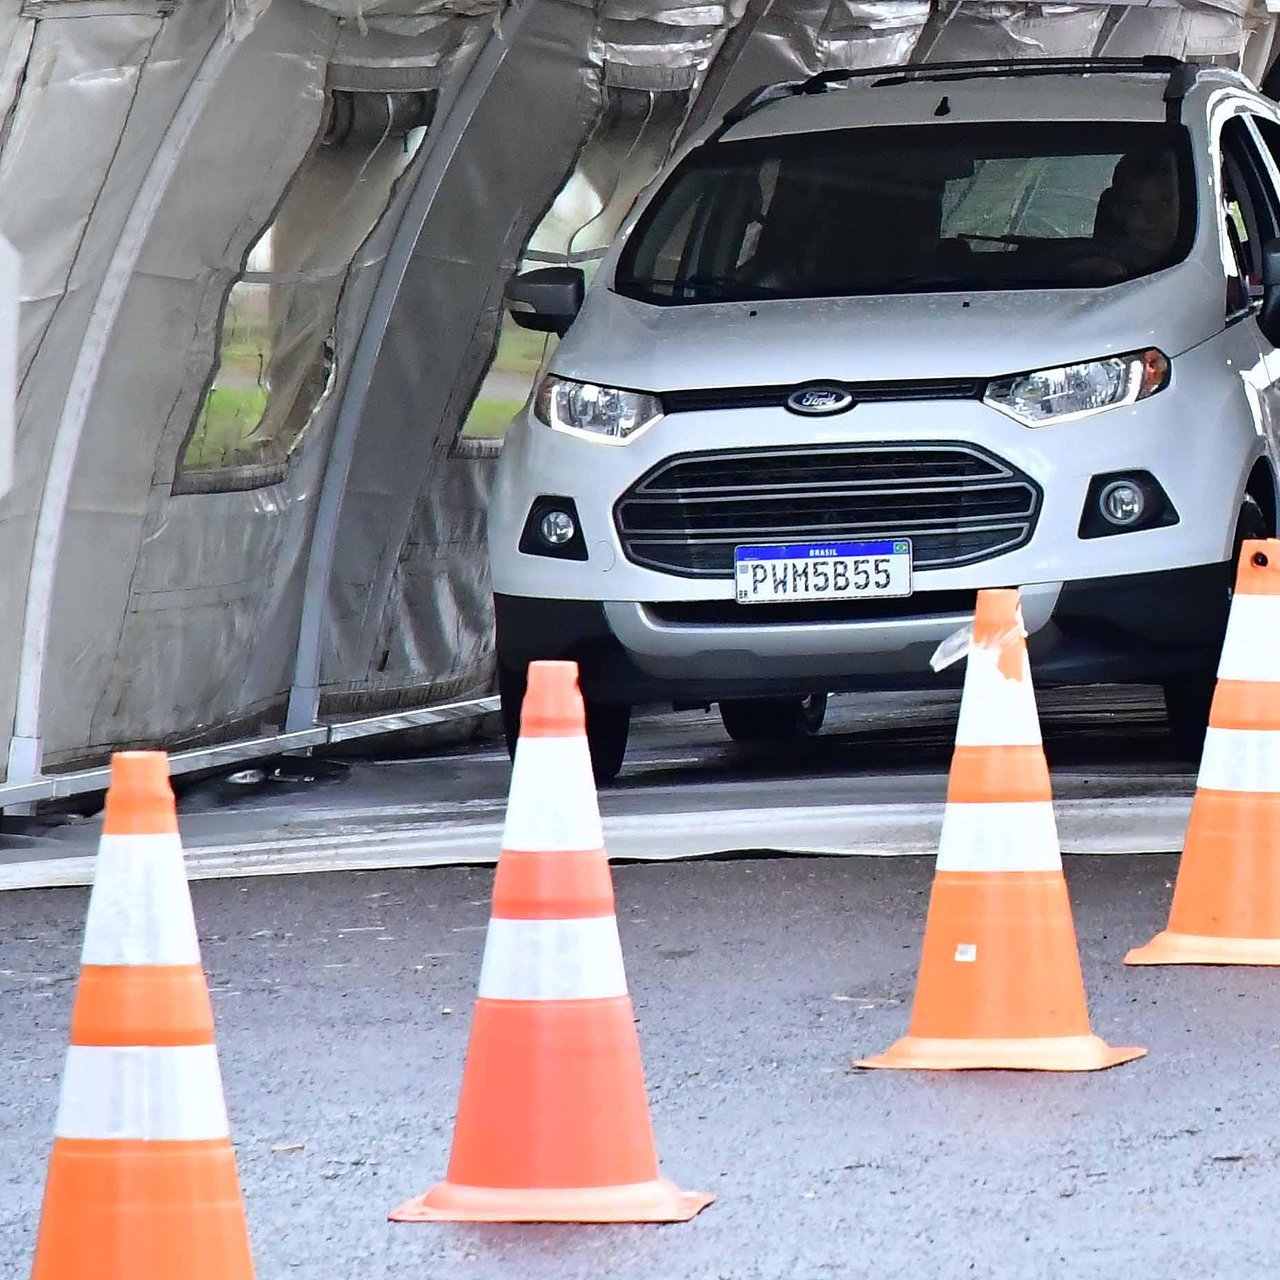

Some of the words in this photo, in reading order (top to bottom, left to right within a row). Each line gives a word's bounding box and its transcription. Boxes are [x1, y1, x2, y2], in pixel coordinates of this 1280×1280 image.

[801, 391, 837, 406] Ford
[808, 548, 838, 558] BRASIL
[750, 558, 892, 595] PWM5B55
